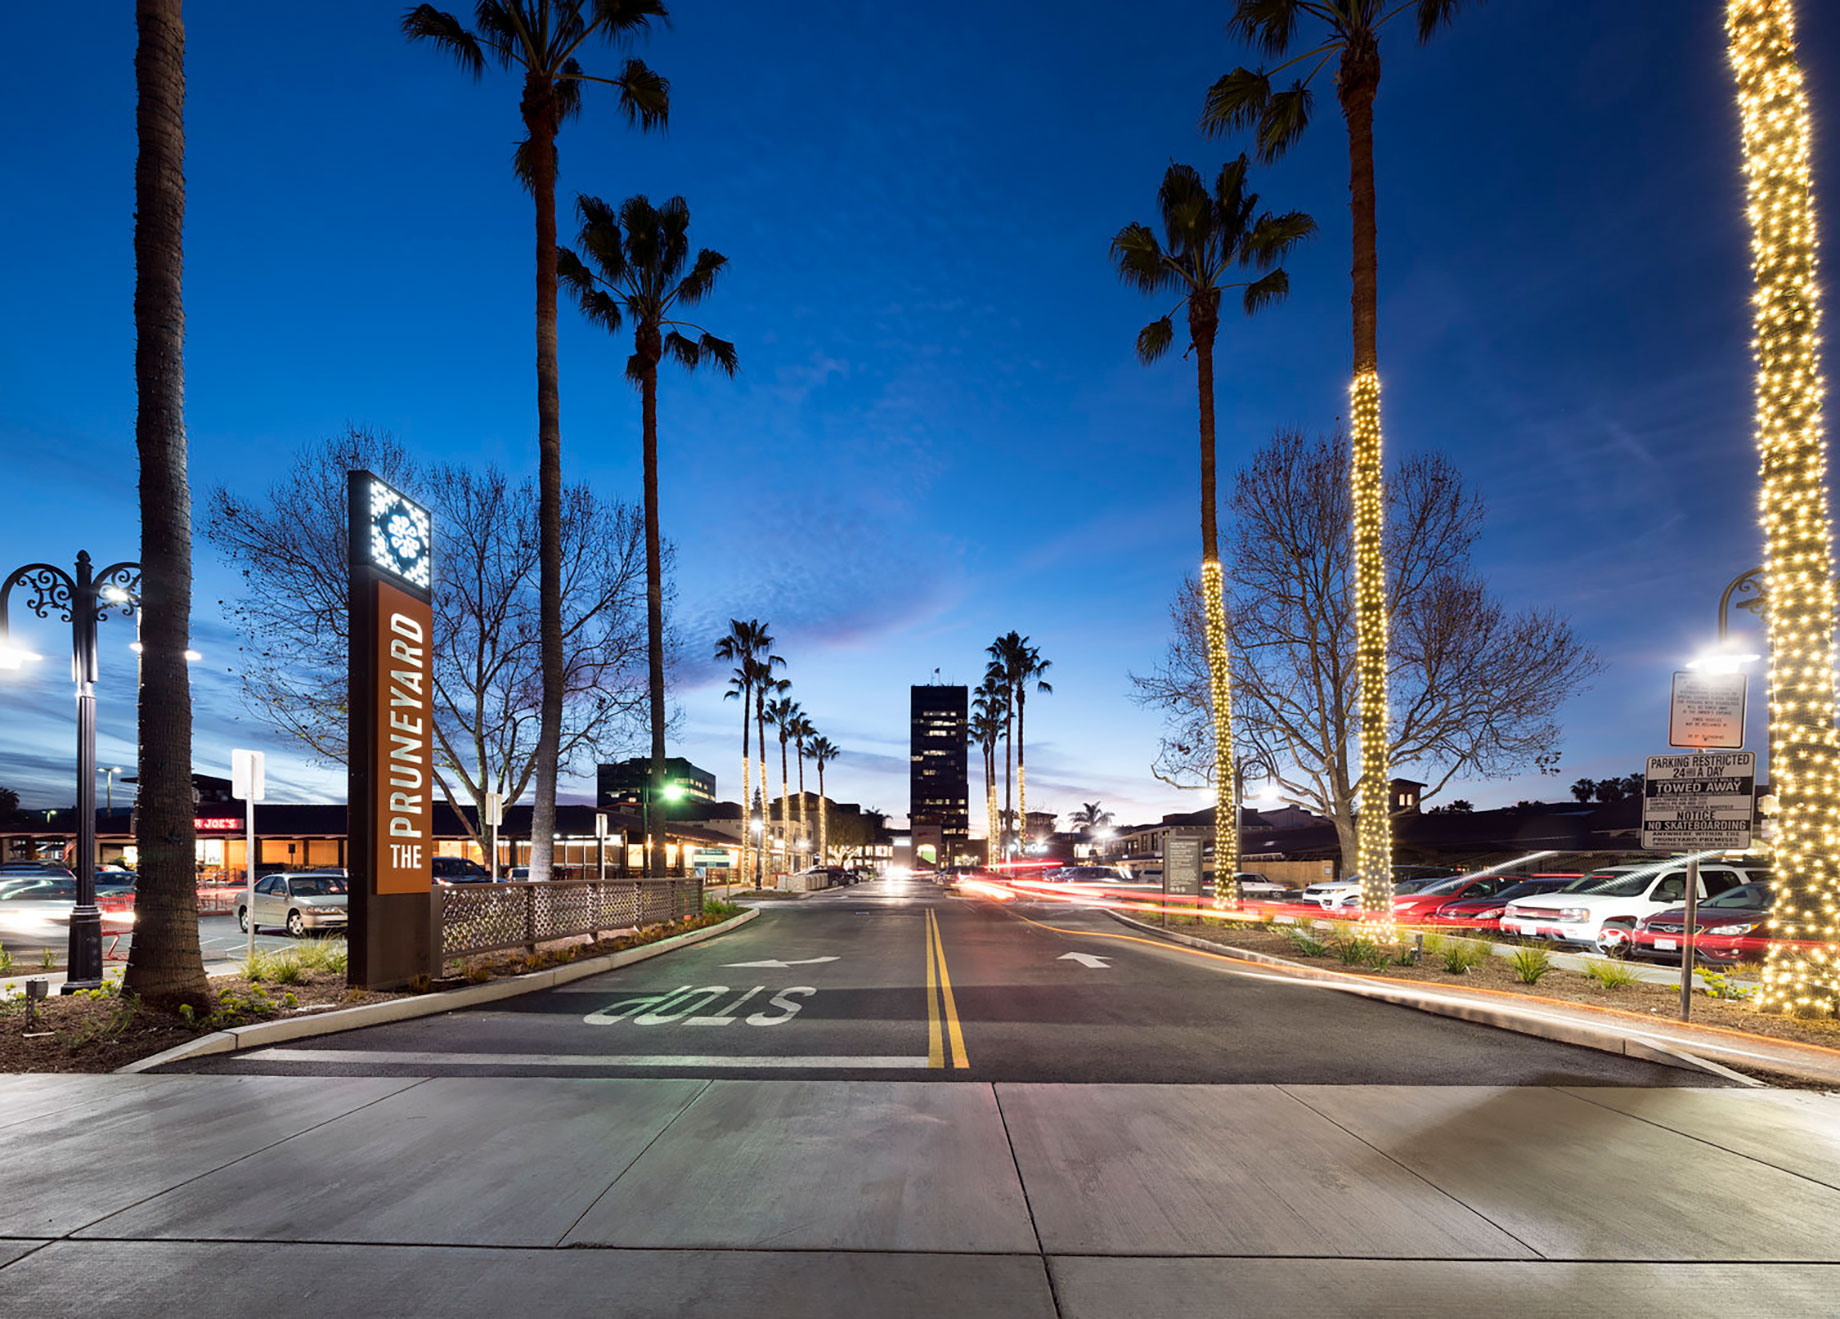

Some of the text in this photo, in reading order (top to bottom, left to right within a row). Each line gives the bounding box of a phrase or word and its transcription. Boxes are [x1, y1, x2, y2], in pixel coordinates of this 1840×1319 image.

[390, 612, 423, 838] PRUNEYARD
[1651, 754, 1750, 769] PARKING RESTRICTED
[1673, 768, 1685, 778] 24
[1697, 767, 1704, 777] A
[1707, 766, 1725, 777] DAY
[1656, 782, 1742, 793] TOWED AWAY
[1676, 811, 1716, 820] NOTICE
[204, 818, 237, 829] JOE'S
[1648, 820, 1747, 830] NO SKATEBOARDING
[390, 843, 422, 869] THE
[583, 985, 818, 1026] STOP
